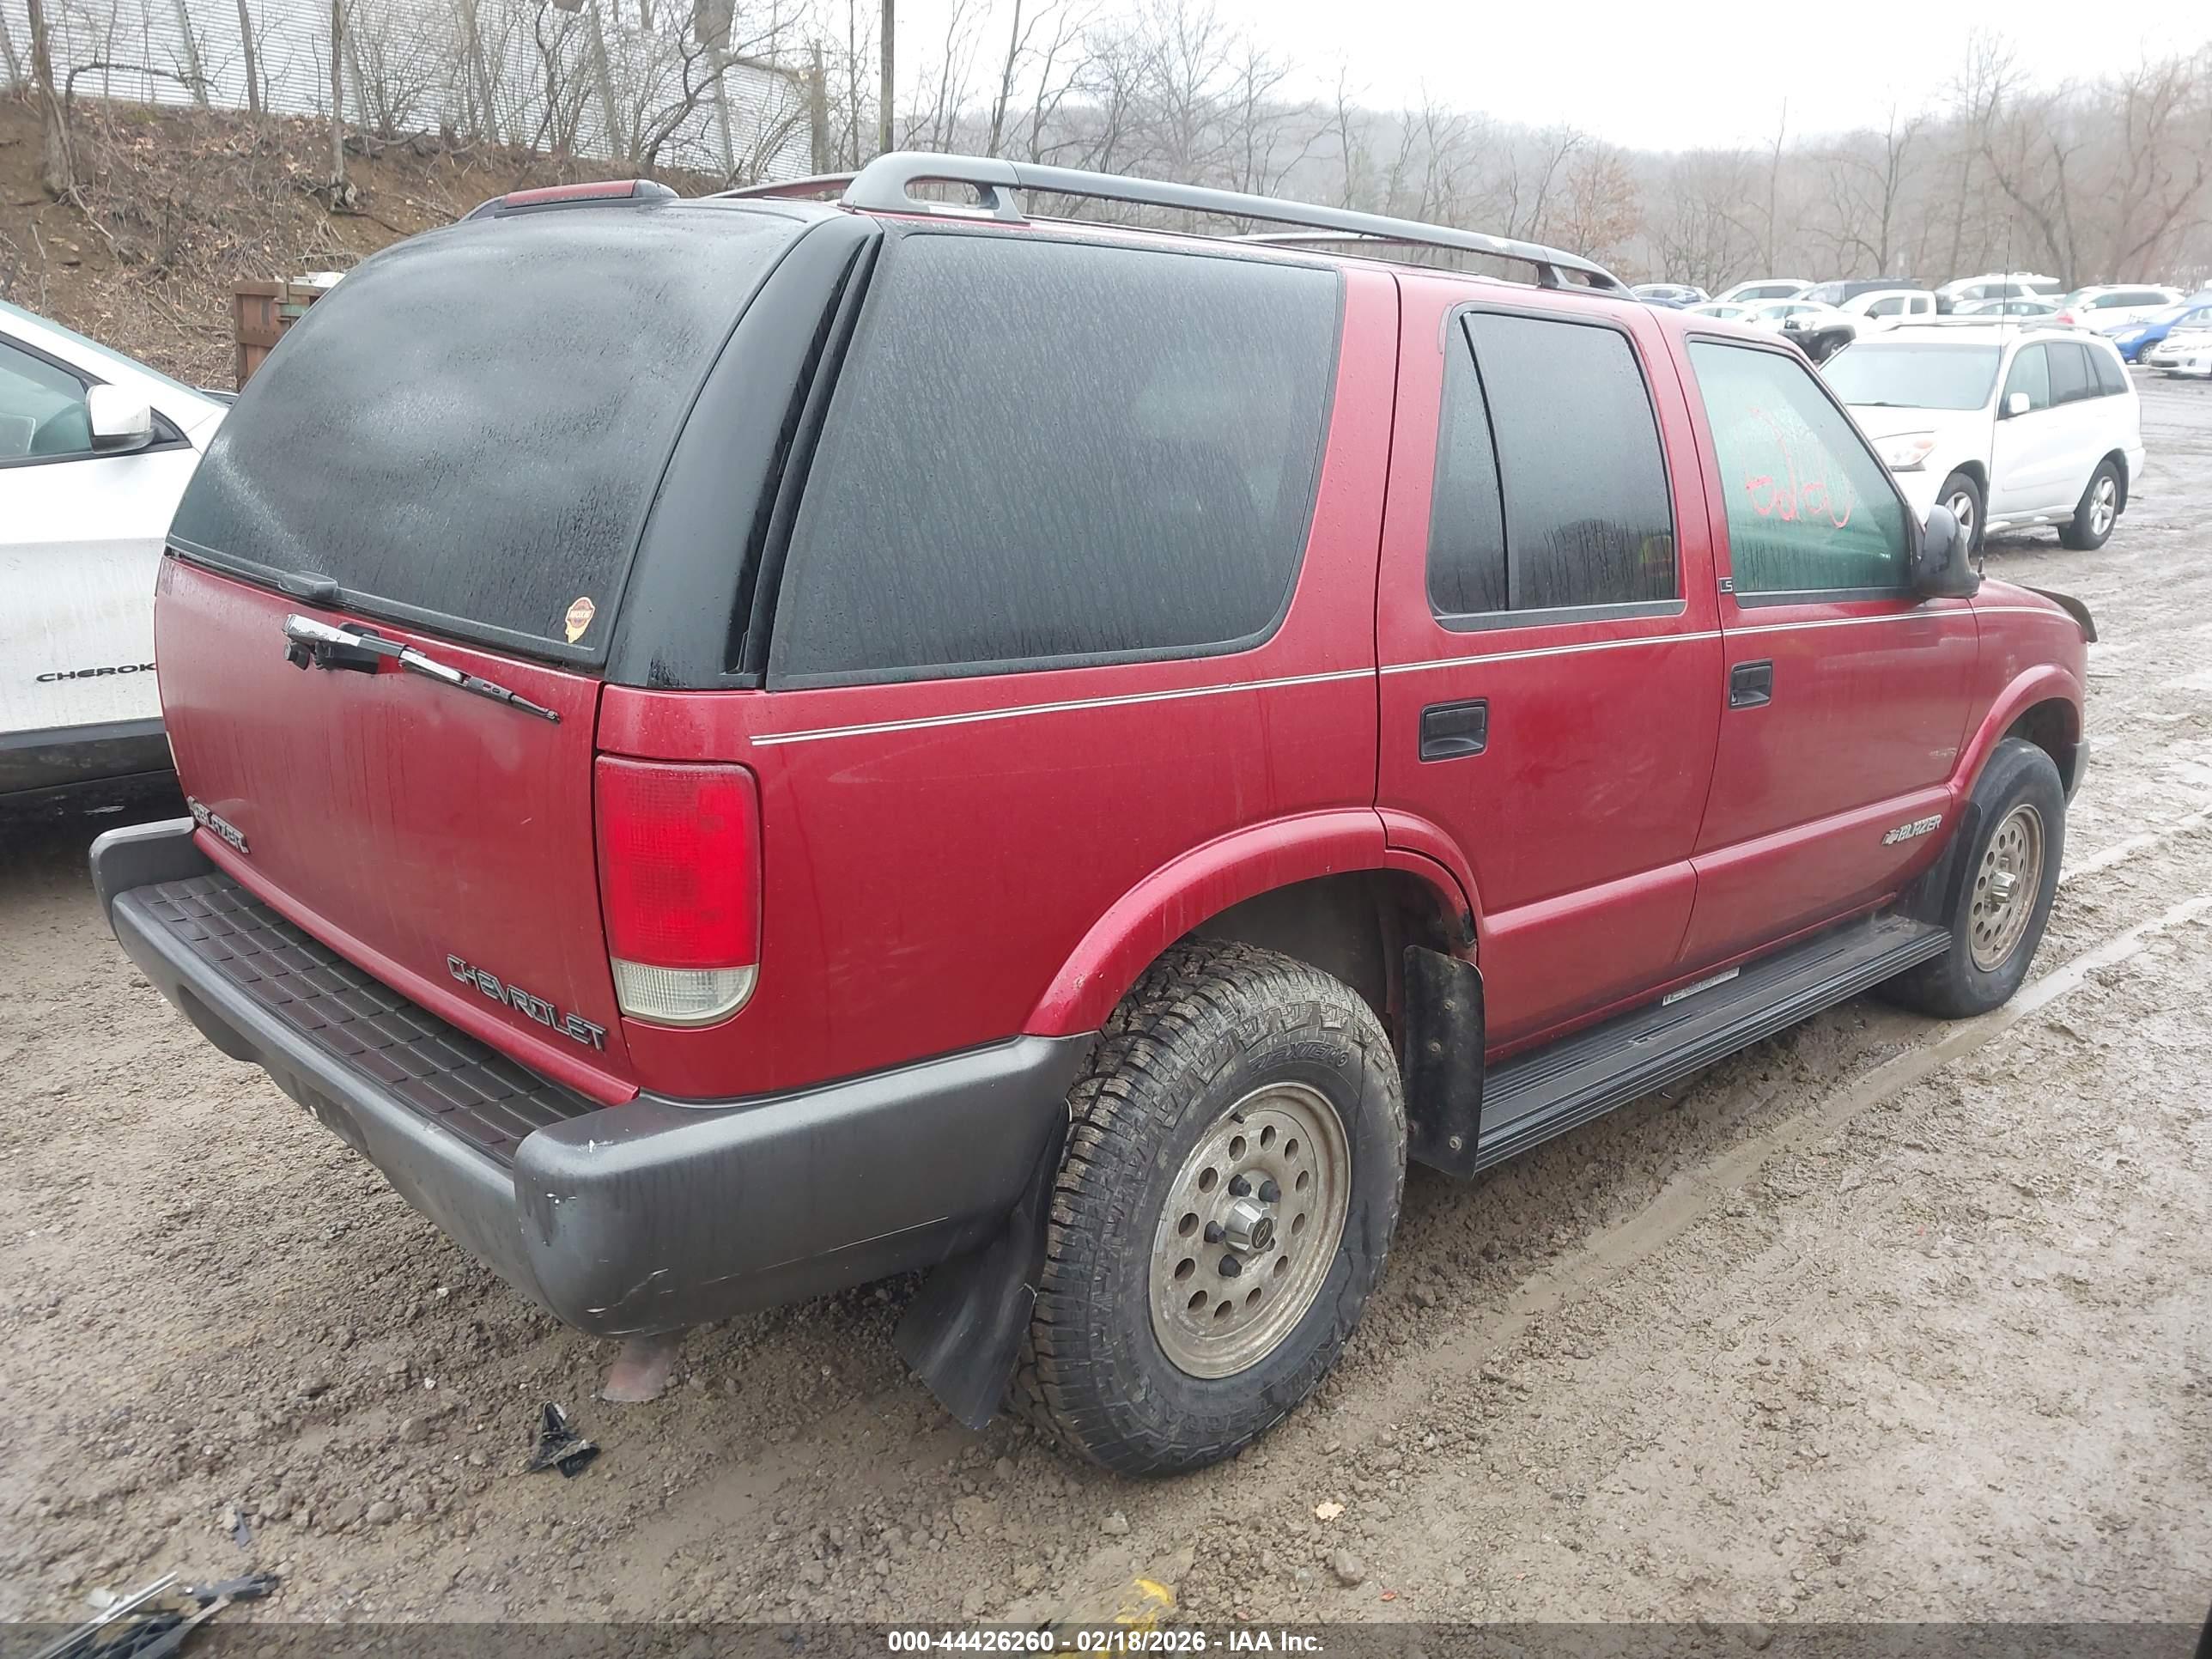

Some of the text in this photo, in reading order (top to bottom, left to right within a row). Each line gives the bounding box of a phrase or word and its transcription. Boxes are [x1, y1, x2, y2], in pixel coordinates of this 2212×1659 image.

[36, 663, 156, 683] CHEROK
[1897, 813, 1942, 842] BLAZER
[447, 953, 606, 1051] CHEVROLET
